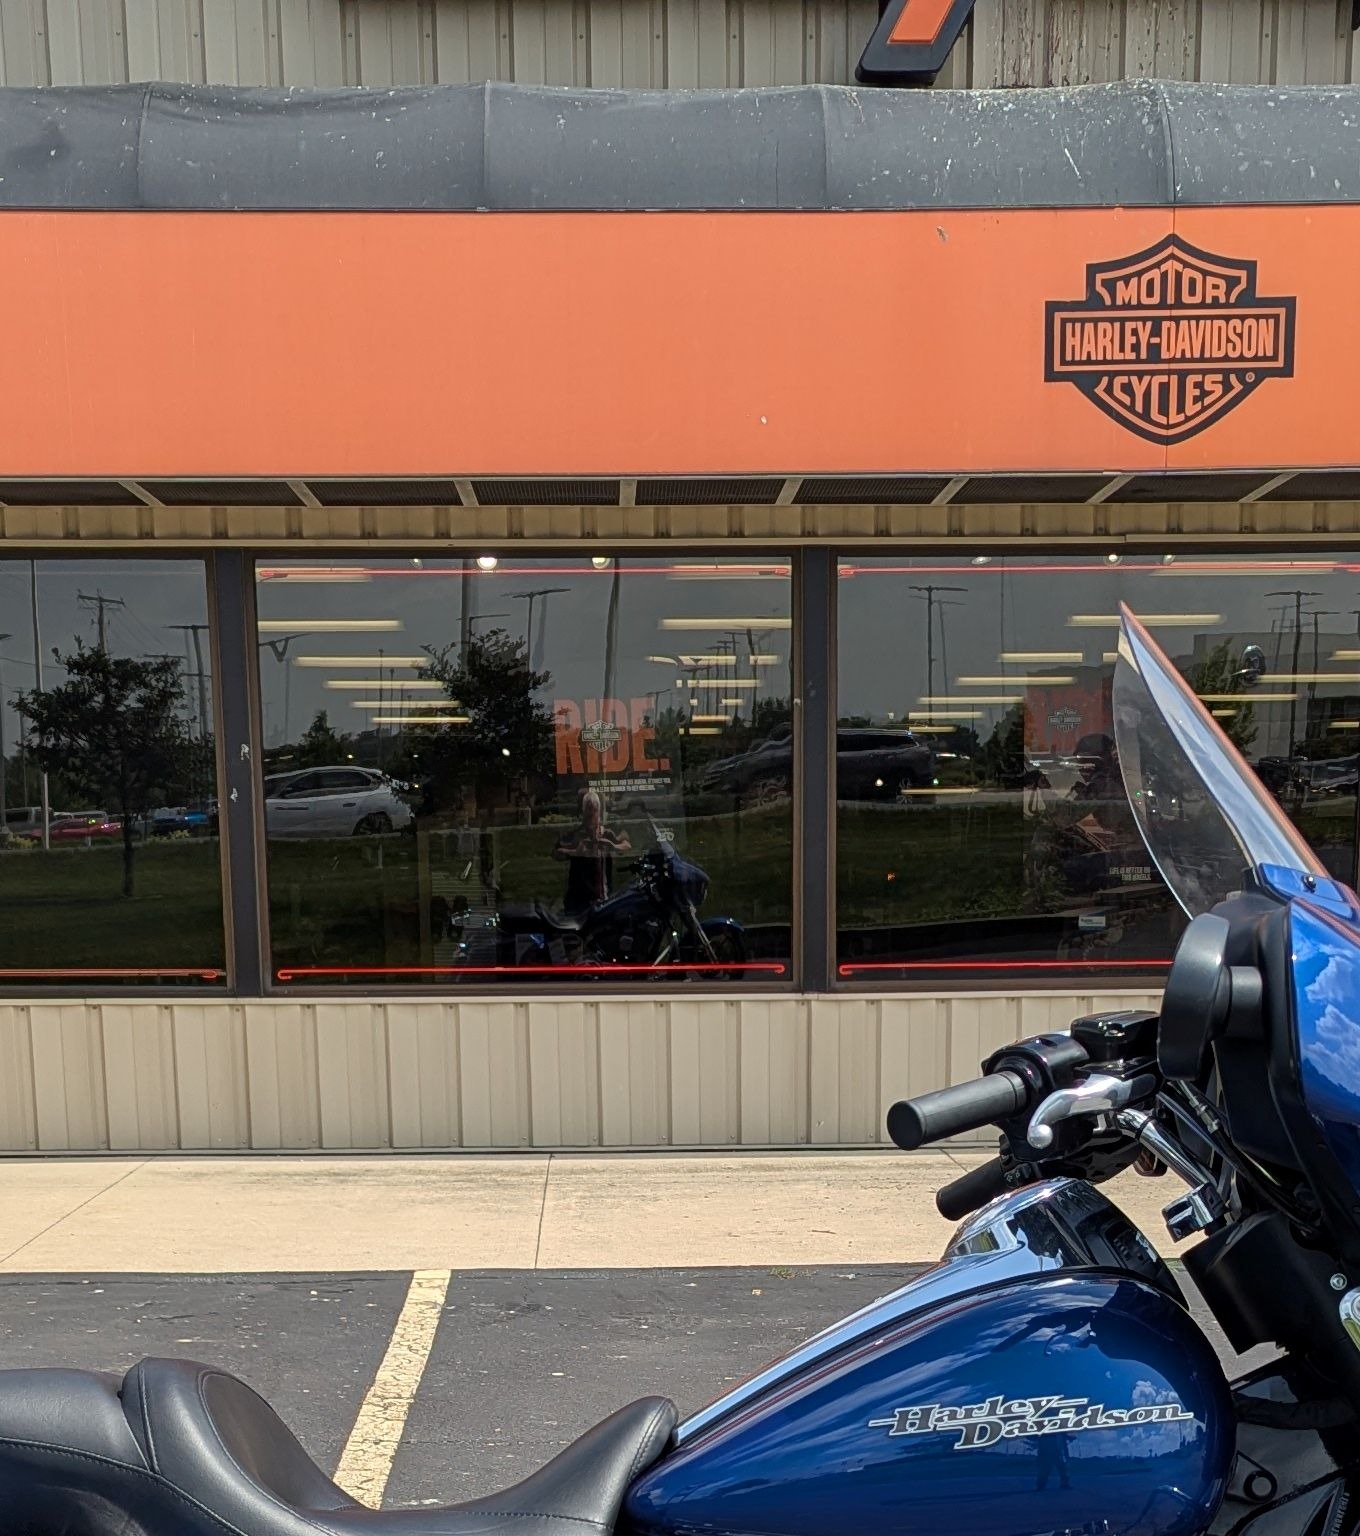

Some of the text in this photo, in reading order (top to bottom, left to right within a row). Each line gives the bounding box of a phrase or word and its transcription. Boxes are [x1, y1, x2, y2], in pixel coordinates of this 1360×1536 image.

[1115, 259, 1226, 305] MOTOR
[1065, 317, 1274, 361] HARLEY-DAVIDSON
[1113, 373, 1224, 425] CYCLES
[953, 1403, 1194, 1450] Davidson
